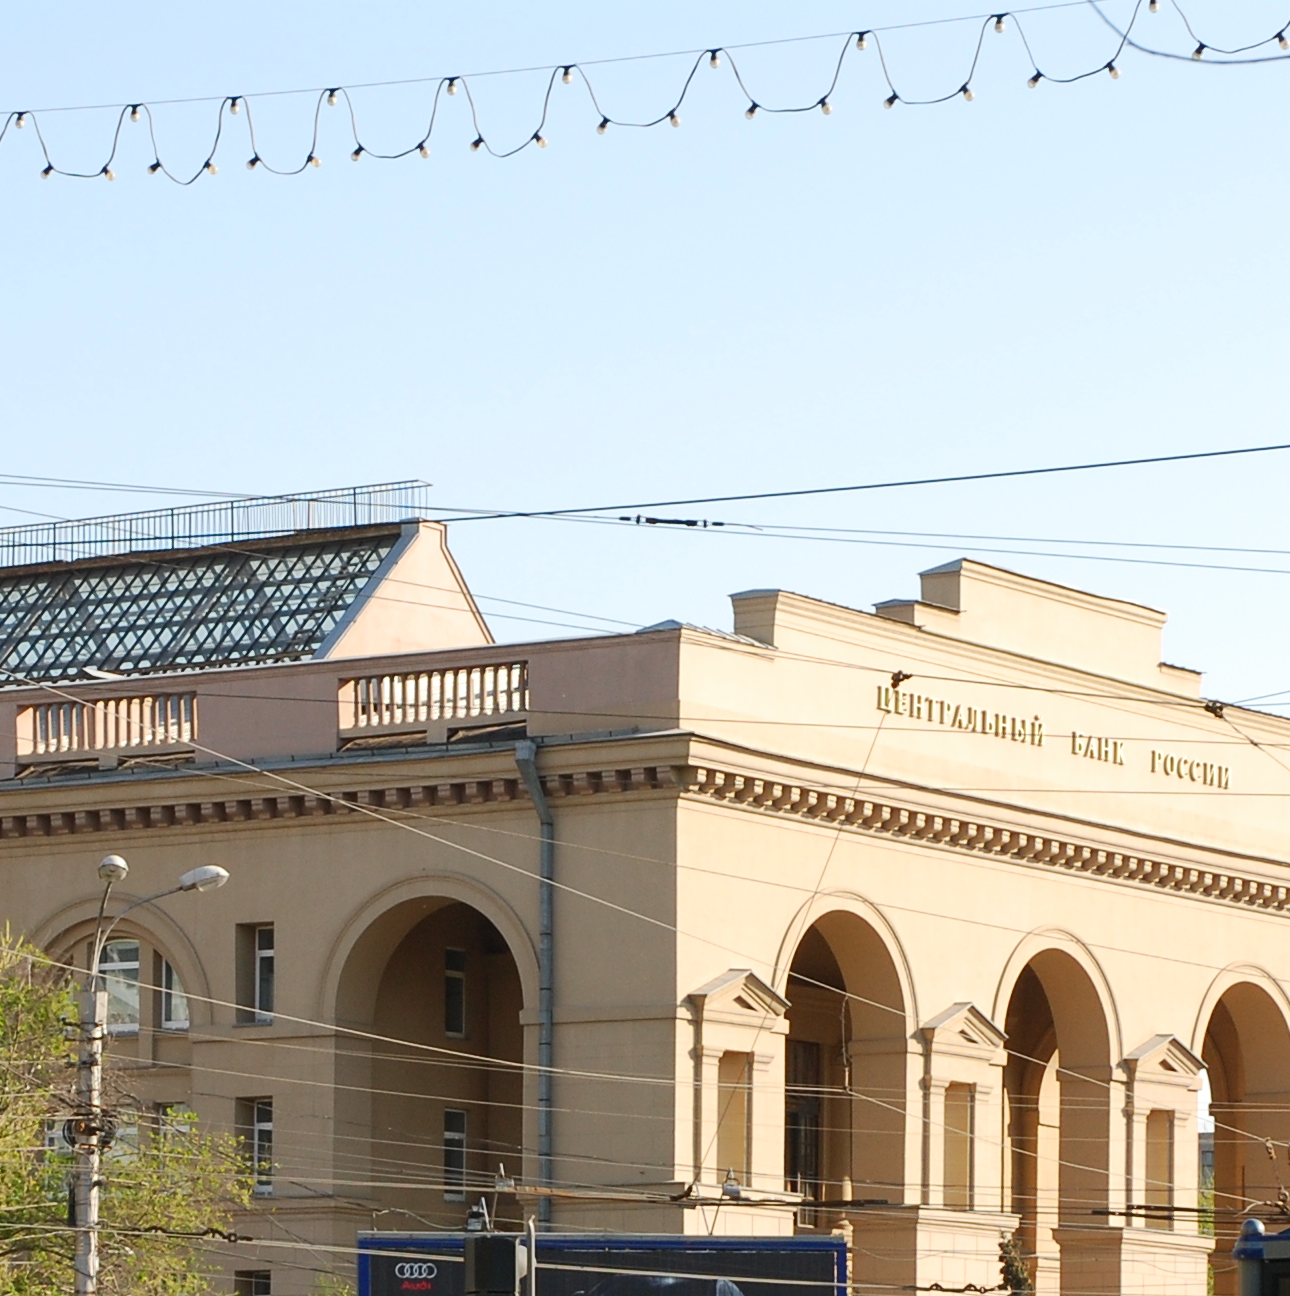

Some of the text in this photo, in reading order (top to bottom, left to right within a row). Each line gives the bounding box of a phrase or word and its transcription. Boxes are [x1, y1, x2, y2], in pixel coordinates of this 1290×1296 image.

[877, 686, 1232, 789] ЦЕНТРАЛЬНЫЙ БАНК РОССИИ
[401, 1281, 432, 1290] Audi
